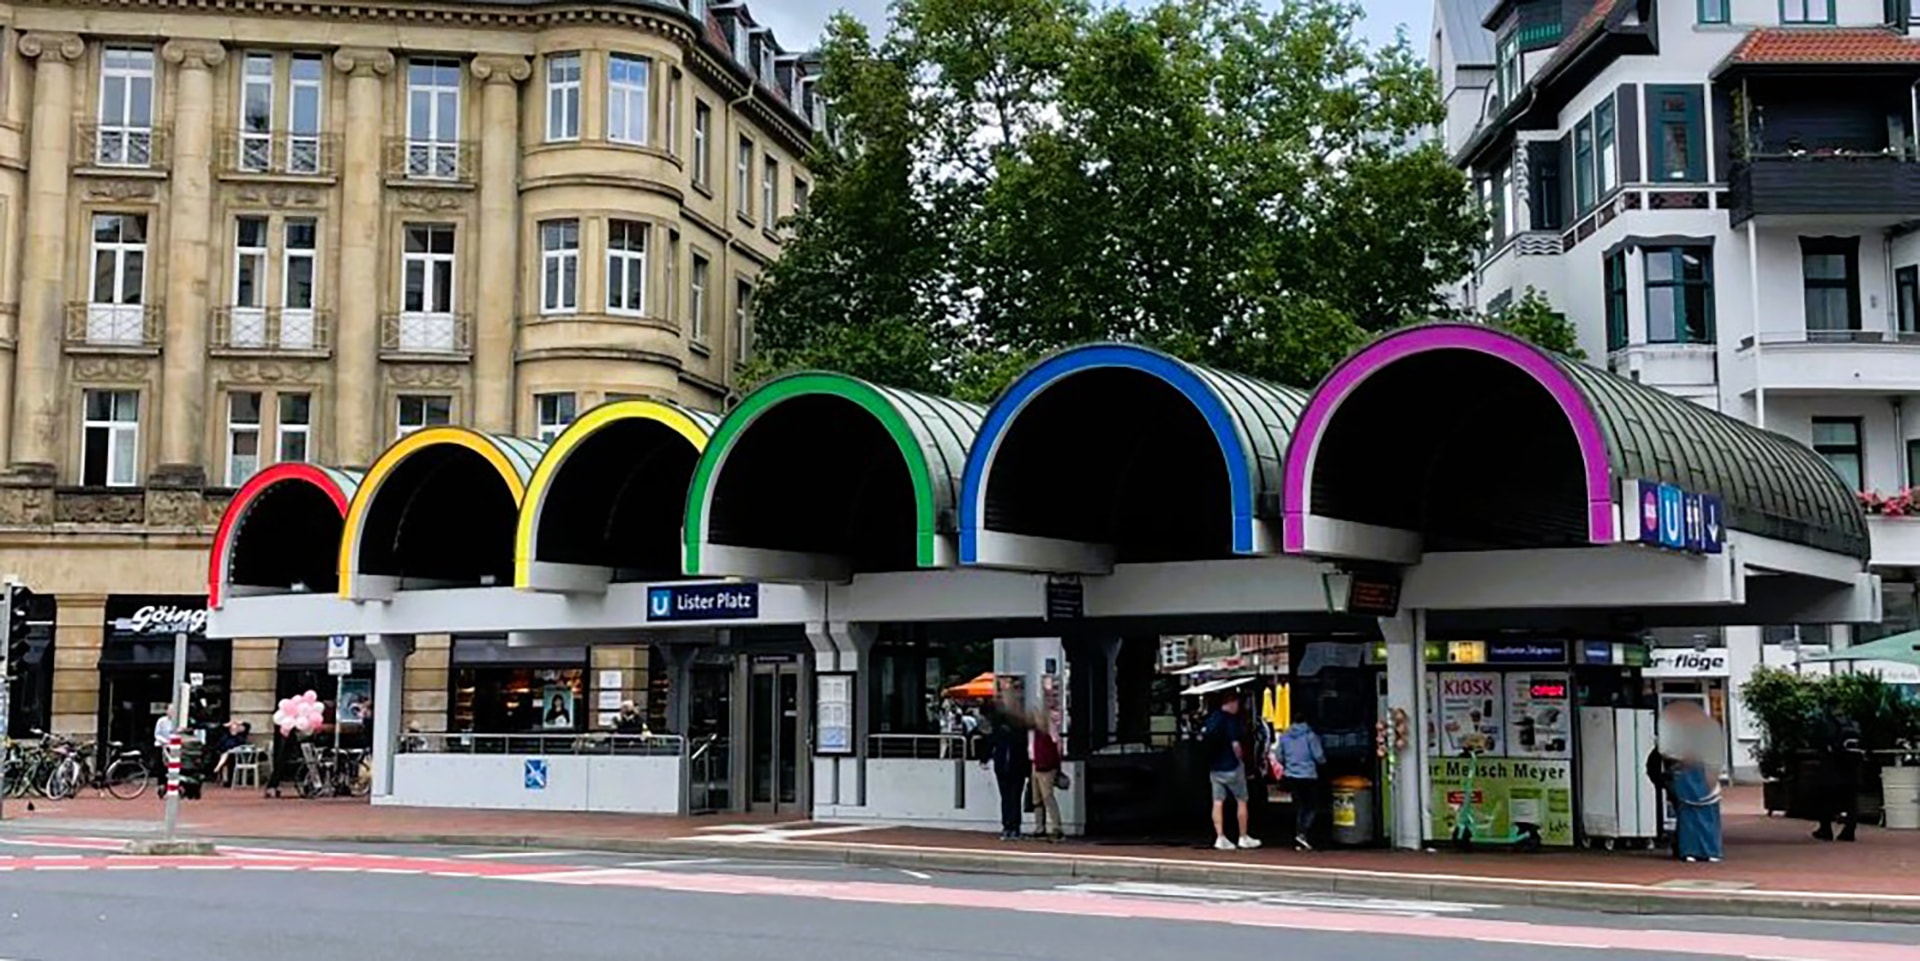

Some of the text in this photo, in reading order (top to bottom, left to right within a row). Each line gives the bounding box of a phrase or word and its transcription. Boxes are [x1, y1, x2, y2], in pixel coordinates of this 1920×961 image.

[652, 592, 751, 616] U Lister Platz
[132, 605, 207, 633] Göing
[1444, 679, 1494, 695] KIOSK
[1513, 763, 1566, 782] Meyer
